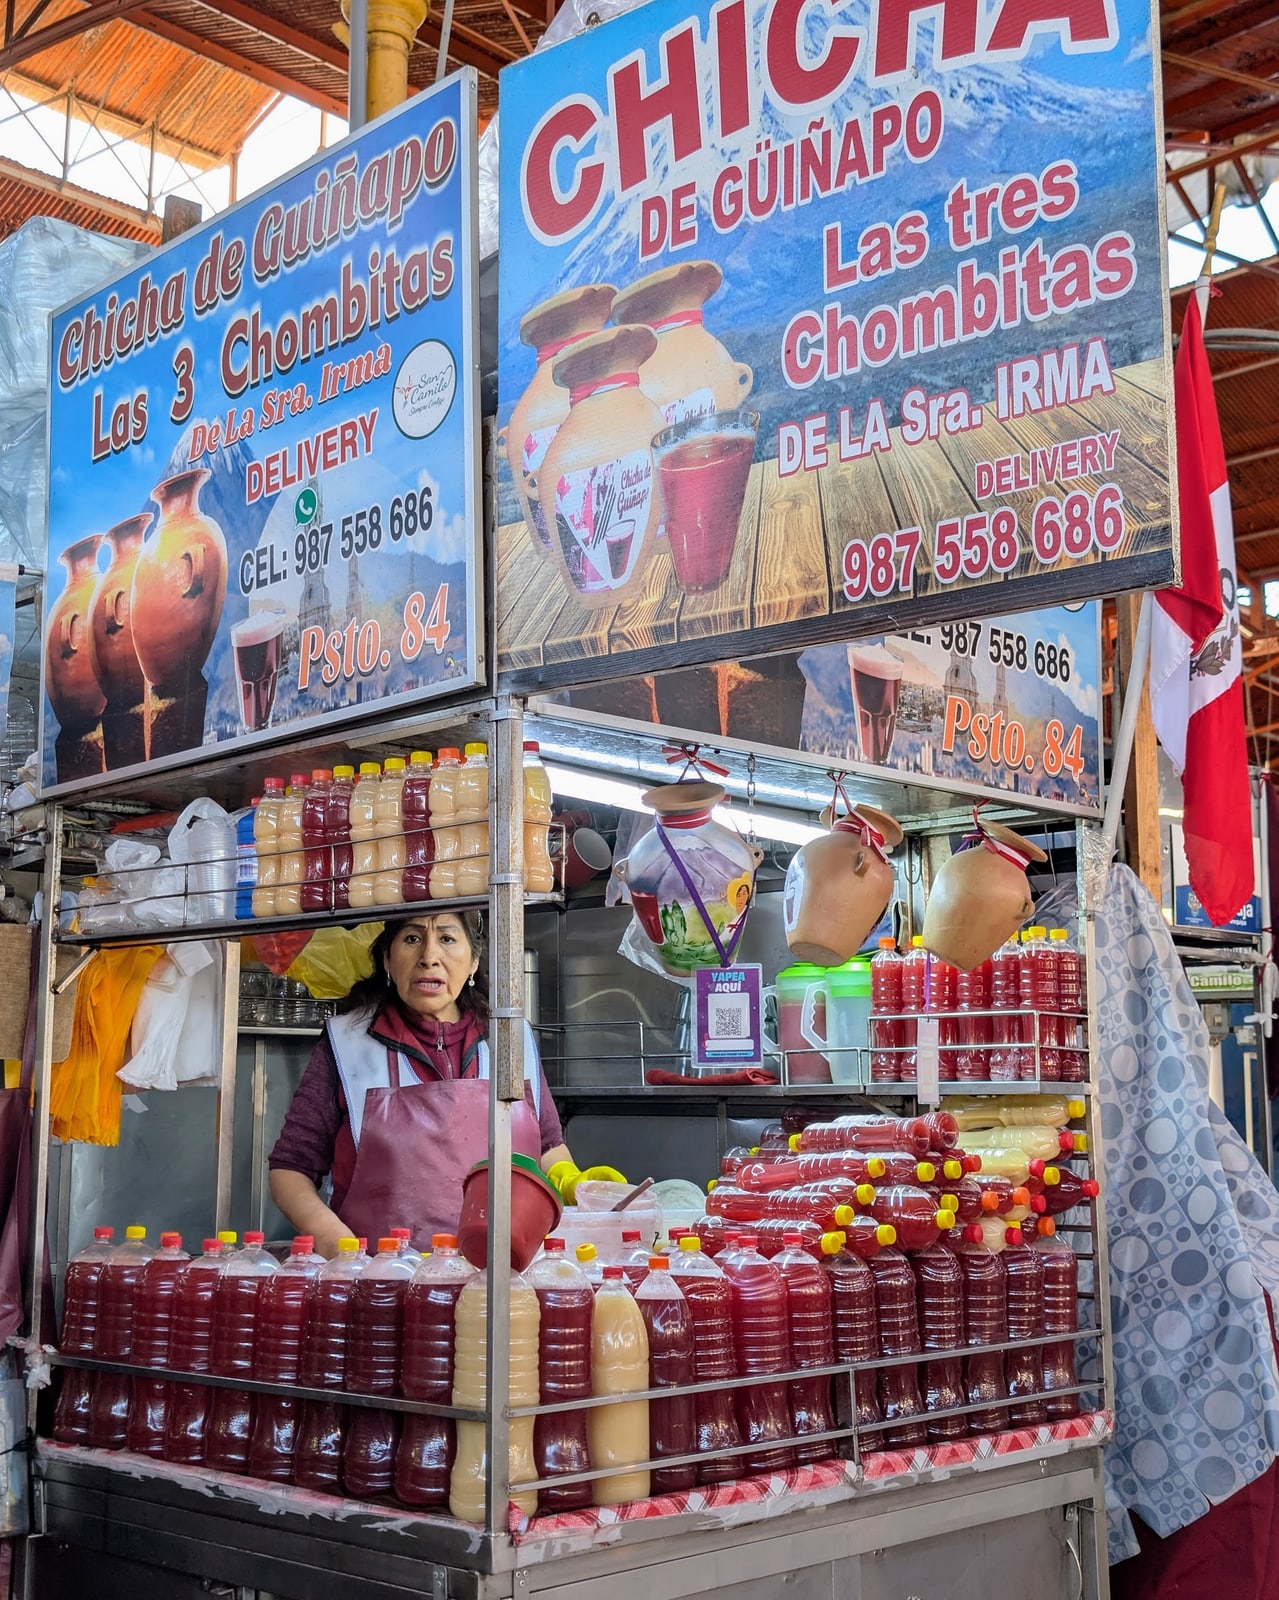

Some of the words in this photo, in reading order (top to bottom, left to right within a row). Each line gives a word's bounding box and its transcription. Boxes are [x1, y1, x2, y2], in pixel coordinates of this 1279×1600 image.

[639, 180, 699, 262] DE
[711, 90, 945, 235] GÜIÑAPO
[822, 211, 929, 294] Las
[945, 159, 1080, 252] tres
[58, 270, 186, 387] Chicha
[194, 234, 245, 310] de
[253, 119, 456, 279] Guiñapo
[92, 393, 148, 461] Las
[170, 347, 195, 422] 3
[221, 237, 454, 396] Chombitas
[781, 231, 1137, 390] Chombitas
[188, 424, 219, 462] De
[223, 410, 254, 447] La
[259, 382, 314, 429] Sra.
[318, 344, 392, 404] Irma
[410, 377, 449, 405] Camilo
[778, 418, 829, 478] DE
[839, 400, 891, 463] LA
[901, 386, 984, 447] Sra.
[996, 337, 1116, 423] IRMA
[246, 410, 379, 503] DELIVERY
[975, 429, 1122, 500] DELIVERY
[240, 543, 288, 595] CEL:
[294, 523, 333, 575] 987
[341, 505, 381, 558] 558
[390, 486, 433, 541] 686
[842, 524, 922, 603] 987
[934, 506, 1018, 587] 558
[1032, 483, 1126, 565] 686
[298, 619, 390, 691] Psto.
[401, 583, 450, 663] 84
[941, 622, 982, 657] 987
[989, 627, 1027, 671] 558
[1034, 641, 1070, 683] 686
[943, 695, 1034, 772] Psto.
[1043, 719, 1084, 778] 84
[711, 972, 745, 982] YAPEA
[715, 981, 742, 993] AQUÍ
[1190, 974, 1242, 987] Camilo
